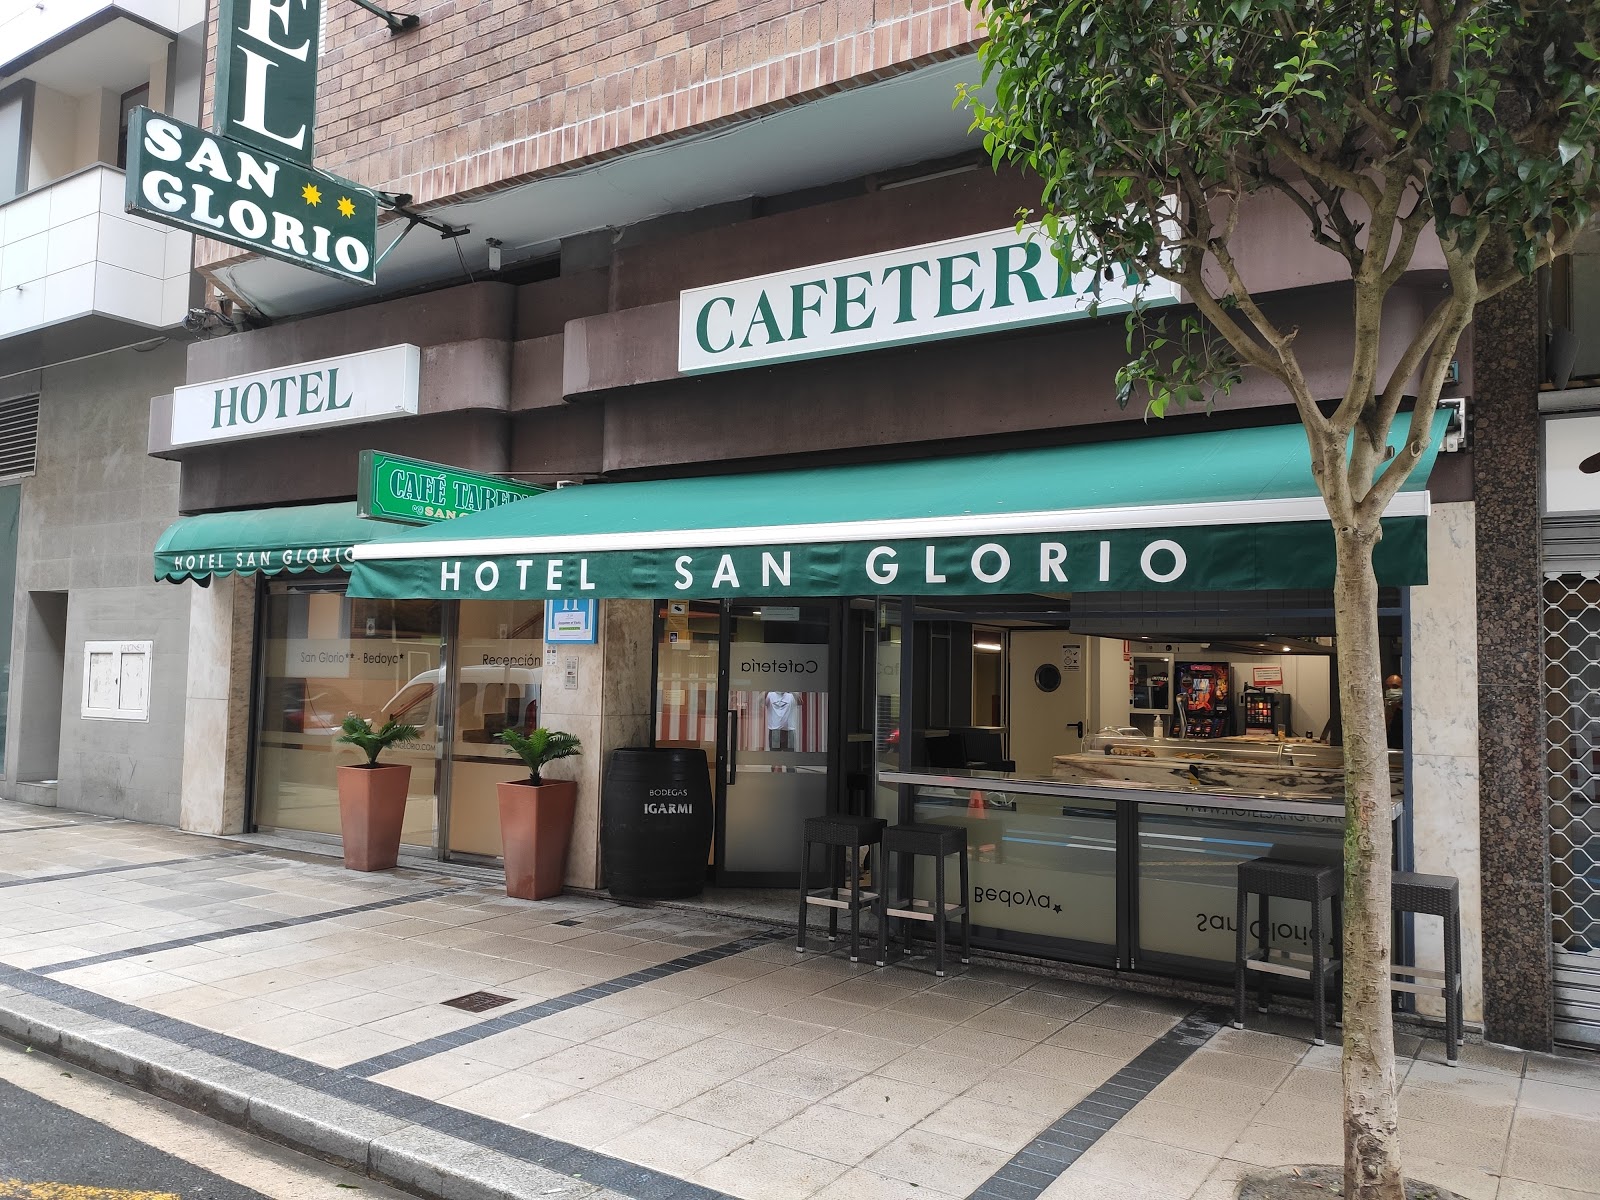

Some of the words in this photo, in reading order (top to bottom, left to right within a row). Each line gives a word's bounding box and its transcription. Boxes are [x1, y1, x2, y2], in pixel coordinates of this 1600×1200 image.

[144, 118, 280, 198] SAN
[142, 170, 369, 273] GLORIO
[211, 367, 353, 429] HOTEL
[389, 469, 446, 506] CAFÉ
[424, 506, 457, 520] SAN
[174, 553, 224, 571] HOTEL
[236, 551, 271, 568] SAN
[440, 557, 596, 592] HOTEL
[674, 549, 791, 590] SAN
[865, 538, 1188, 586] GLORIO
[300, 651, 316, 663] San
[482, 653, 541, 668] Recepción
[649, 788, 688, 797] BODEGAS
[644, 803, 693, 814] IGARMI
